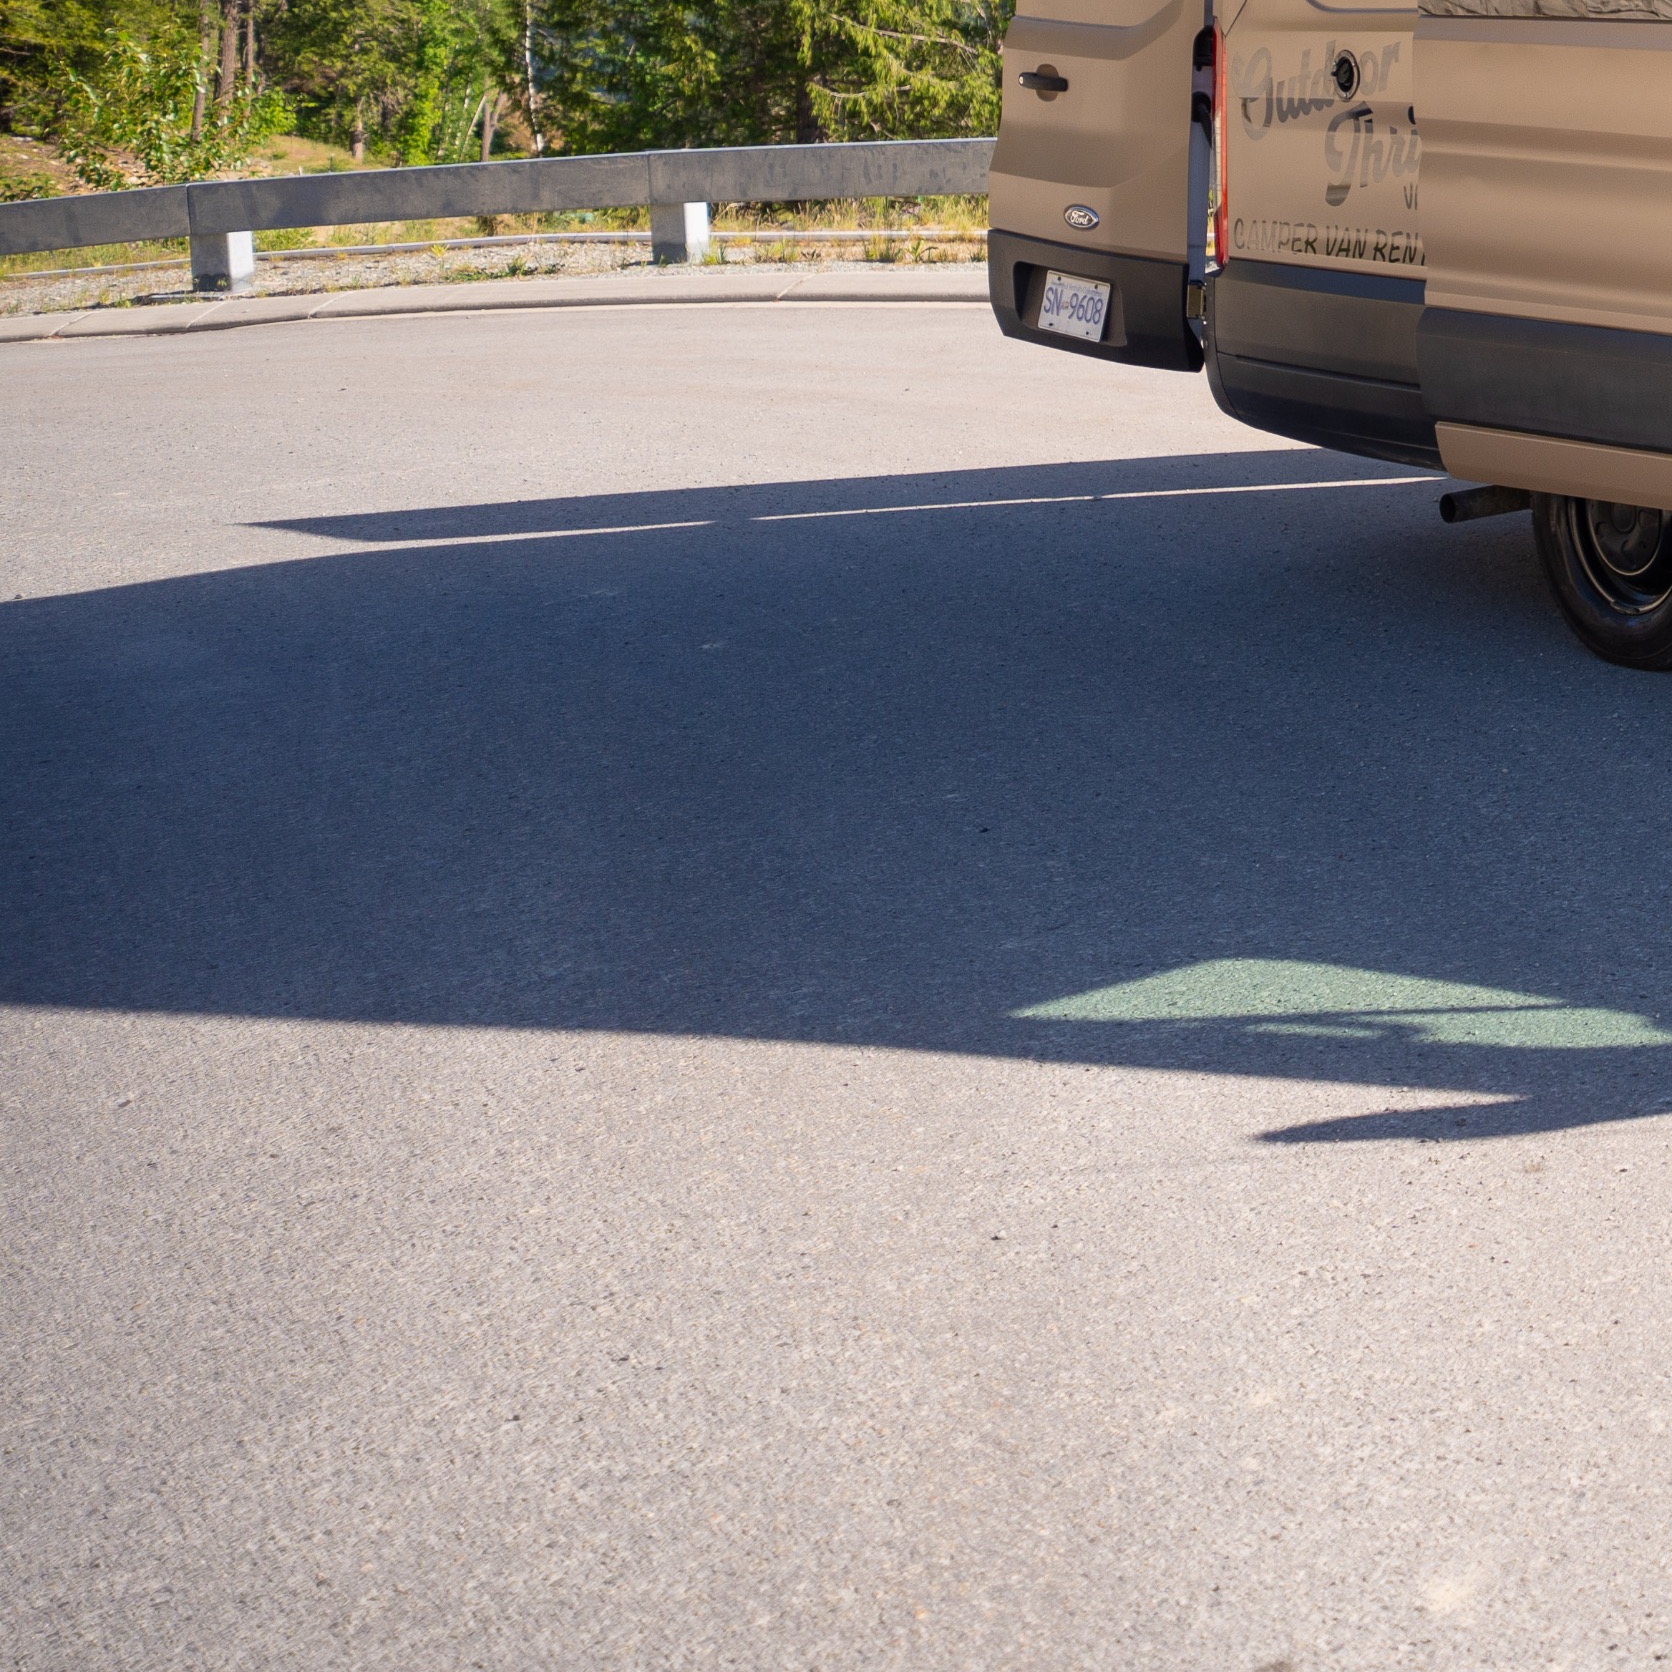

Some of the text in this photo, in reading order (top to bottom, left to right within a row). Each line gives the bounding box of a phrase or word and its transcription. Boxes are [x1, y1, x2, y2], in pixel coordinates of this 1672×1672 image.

[1232, 40, 1401, 141] Outdor
[1234, 218, 1318, 255] CAMPER
[1326, 225, 1368, 259] VAN
[1068, 293, 1104, 325] 9608
